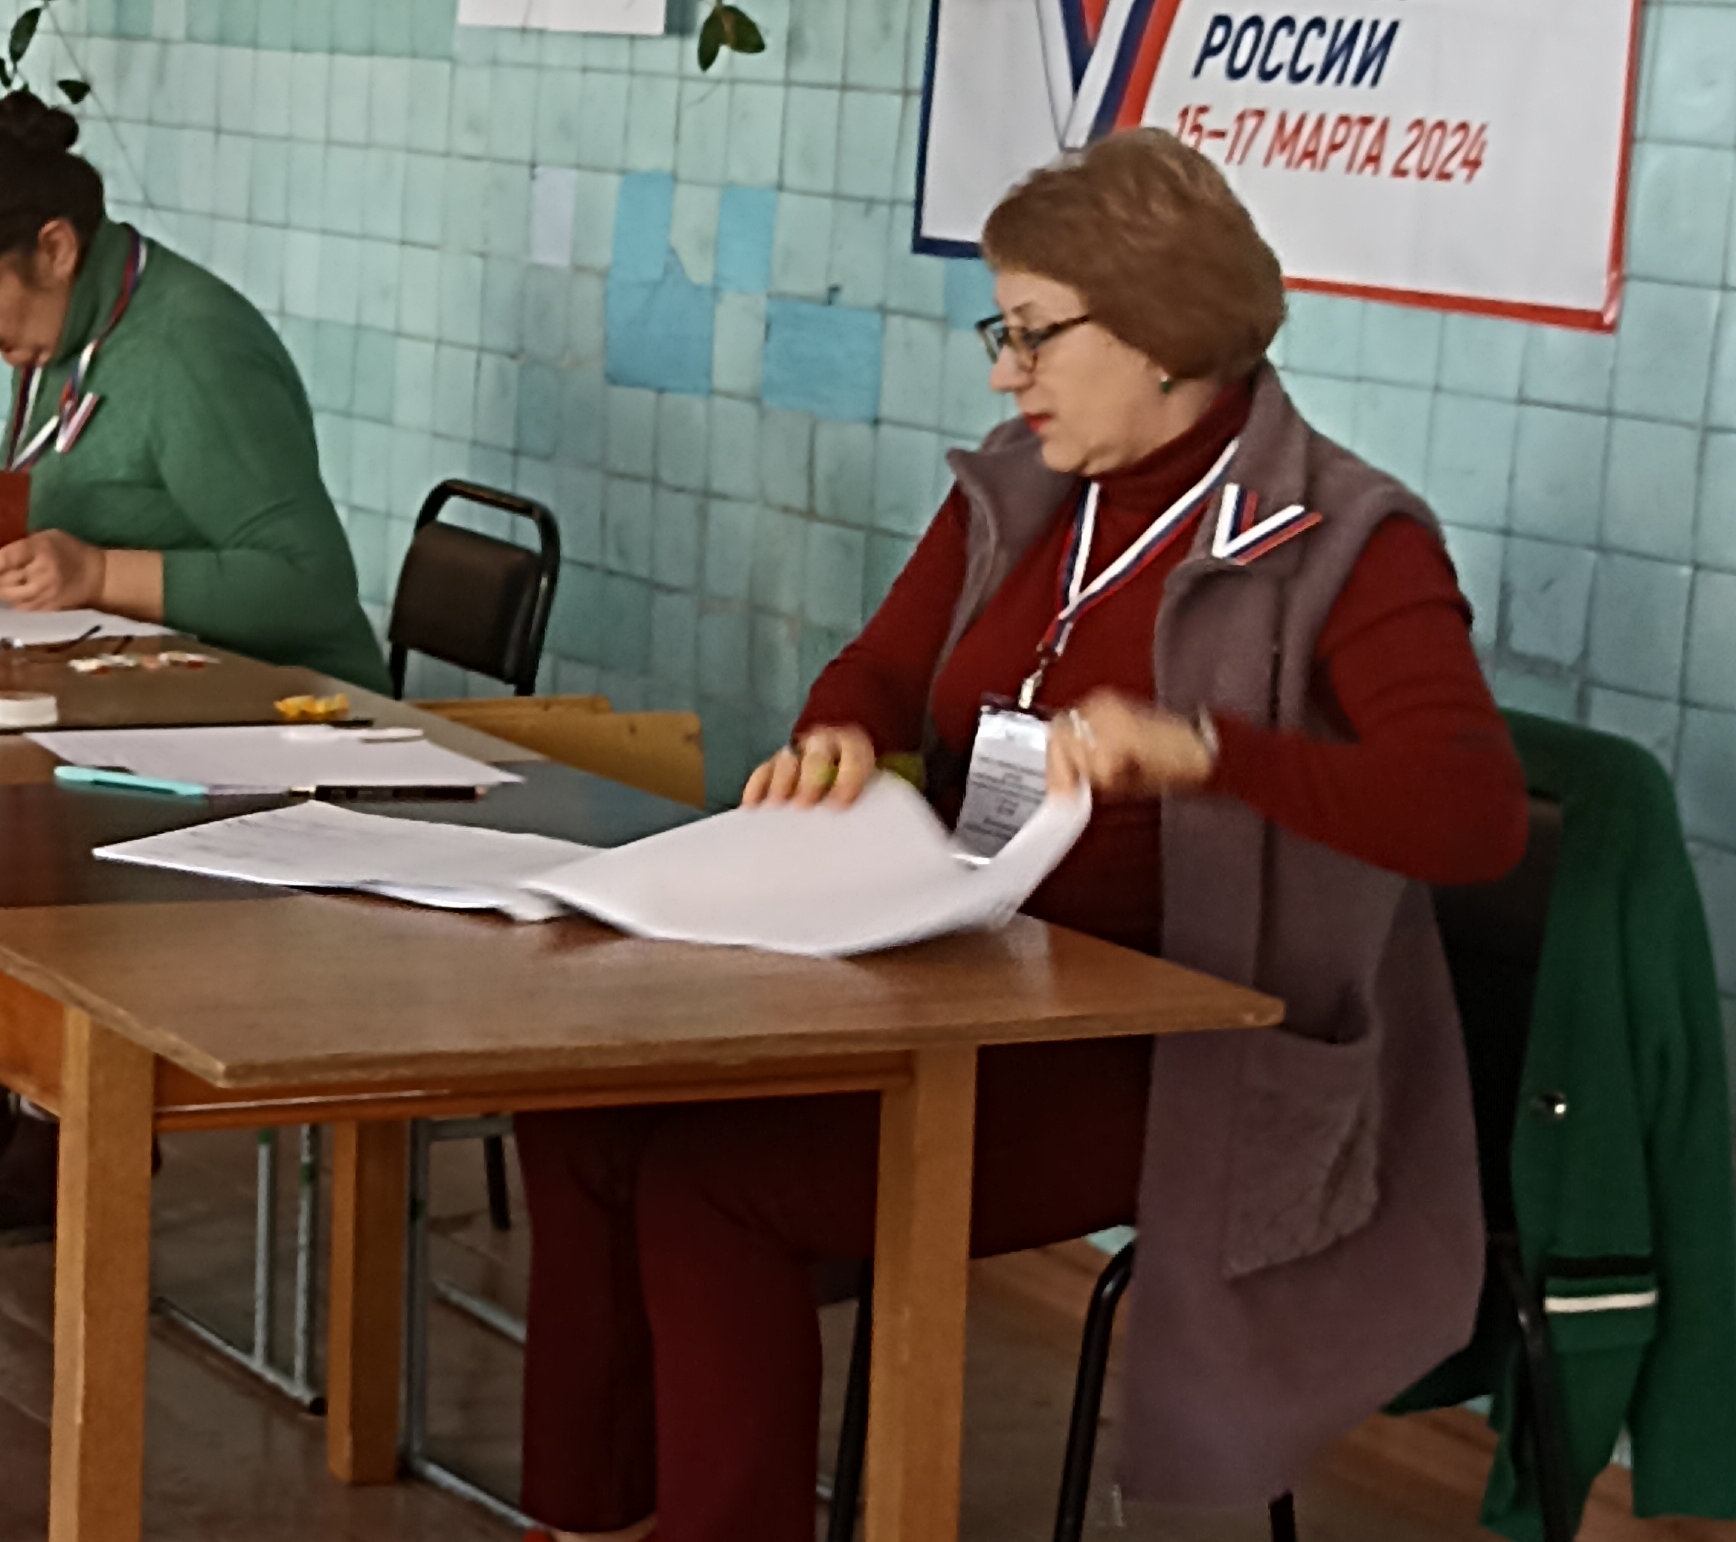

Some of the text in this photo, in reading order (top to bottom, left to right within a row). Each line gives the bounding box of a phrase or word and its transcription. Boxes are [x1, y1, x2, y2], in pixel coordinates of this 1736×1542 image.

[1192, 13, 1400, 88] РОССИИ
[1262, 109, 1390, 176] МАРТА
[1389, 117, 1489, 184] 2024
